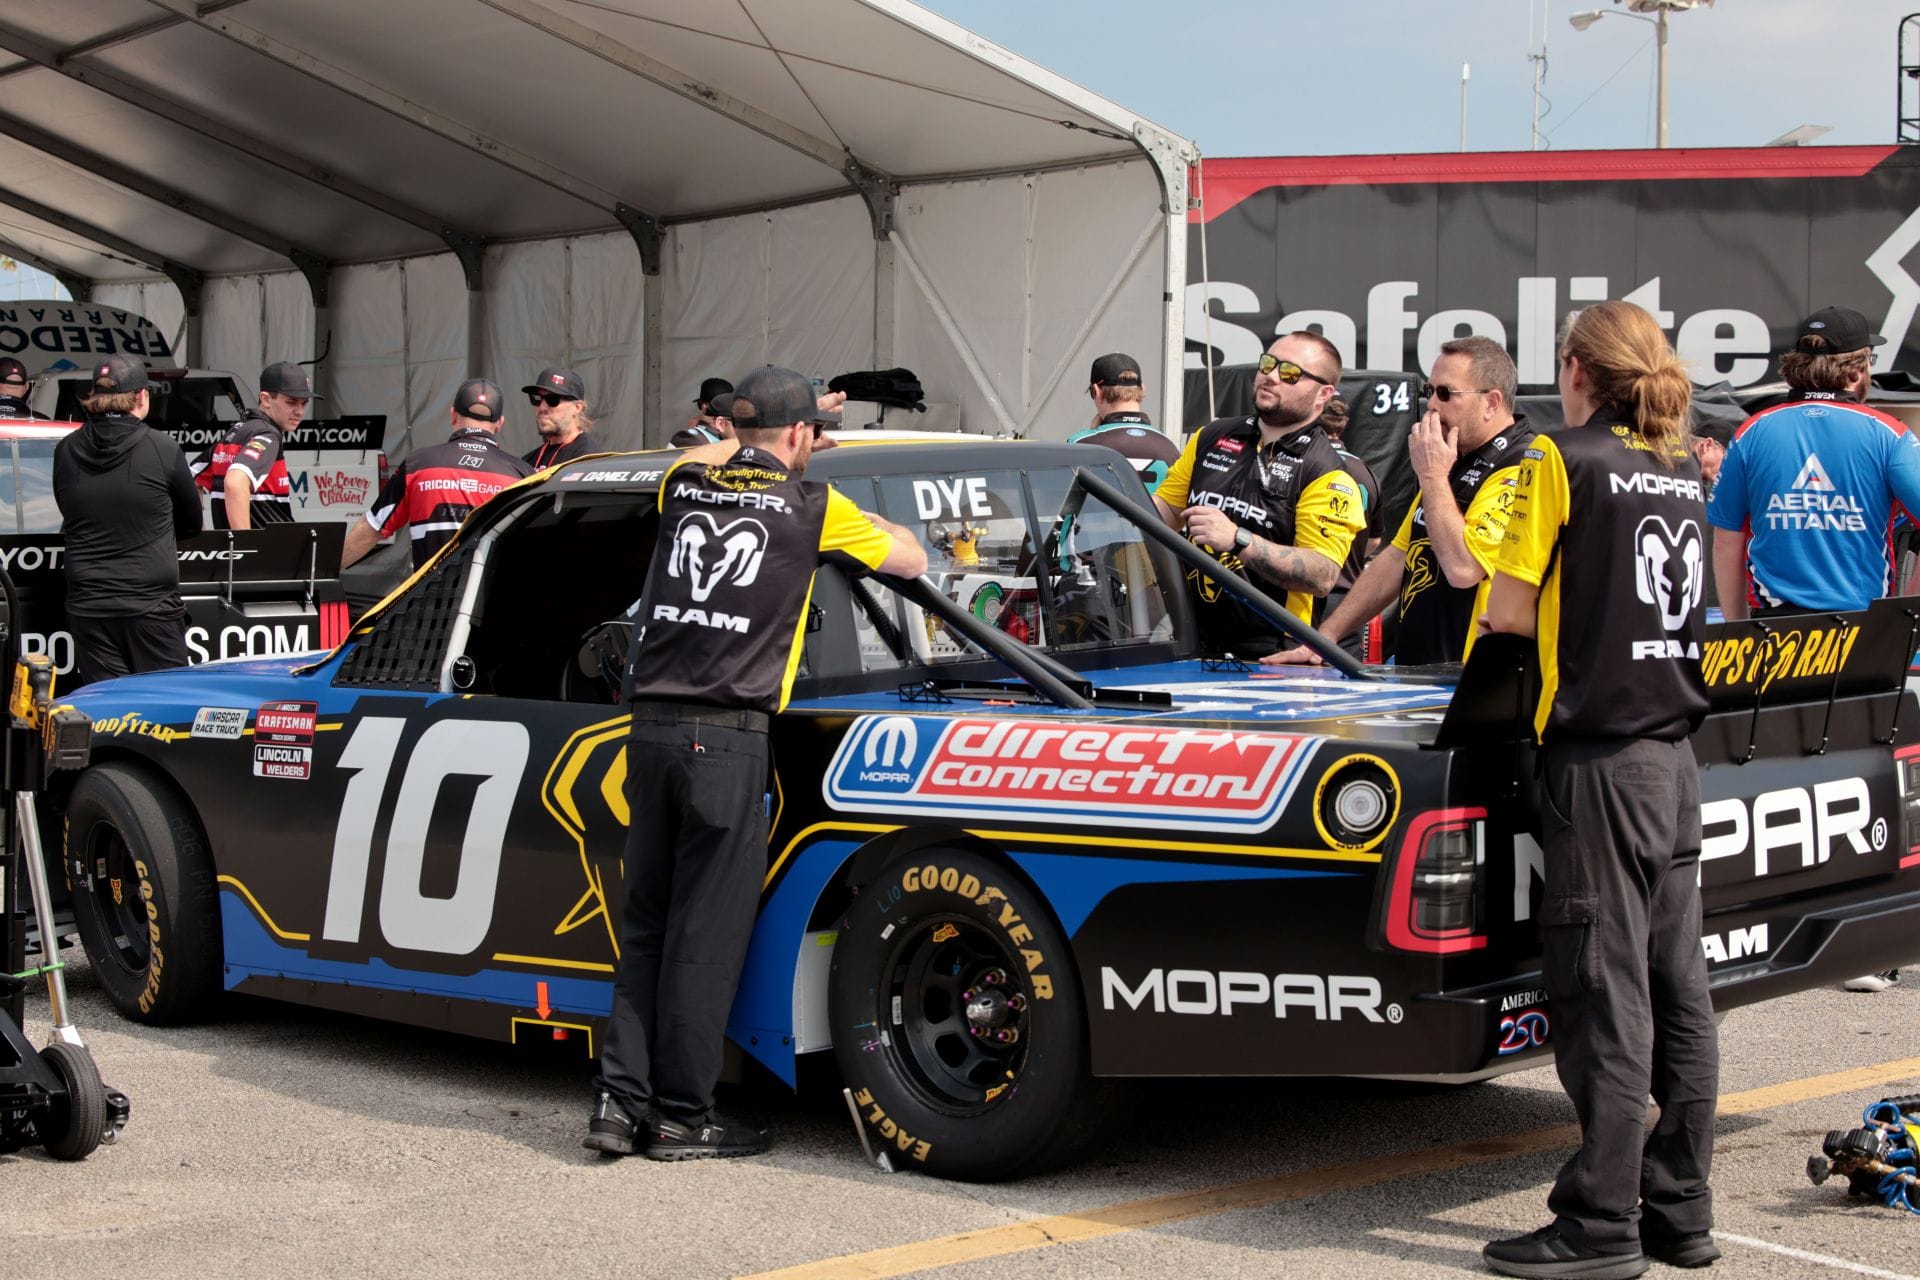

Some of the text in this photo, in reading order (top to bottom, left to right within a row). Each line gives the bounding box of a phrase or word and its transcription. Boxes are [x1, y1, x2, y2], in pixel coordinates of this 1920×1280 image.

[1373, 381, 1409, 415] 34
[458, 442, 487, 451] TOYOTA
[418, 479, 507, 495] TRICON GAR
[581, 470, 664, 482] DANIEL DYE
[1608, 472, 1705, 503] MOPAR
[674, 483, 784, 513] MOPAR
[912, 477, 993, 520] DYE
[1766, 493, 1864, 513] AERIAL
[1765, 513, 1867, 532] TITANS
[0, 546, 66, 571] YOT
[653, 604, 750, 634] RAM
[184, 624, 309, 667] SCOM
[1792, 626, 1861, 678] RAM
[92, 712, 177, 744] ODYEAR
[194, 723, 240, 735] RACE TRUCK
[204, 711, 241, 724] NASCAR
[258, 715, 313, 730] CRAFTSMAN
[257, 747, 302, 763] LINCOLN
[948, 721, 1220, 764] direct
[266, 764, 305, 777] WELDERS
[859, 770, 911, 784] MOPAR
[931, 761, 1250, 800] connection
[322, 716, 530, 955] 10
[135, 860, 164, 1014] GOODYEAR
[902, 864, 1054, 1001] GOODYEAR
[1701, 922, 1768, 963] AM
[1498, 1008, 1550, 1055] 250
[853, 1086, 933, 1163] EAGLE
